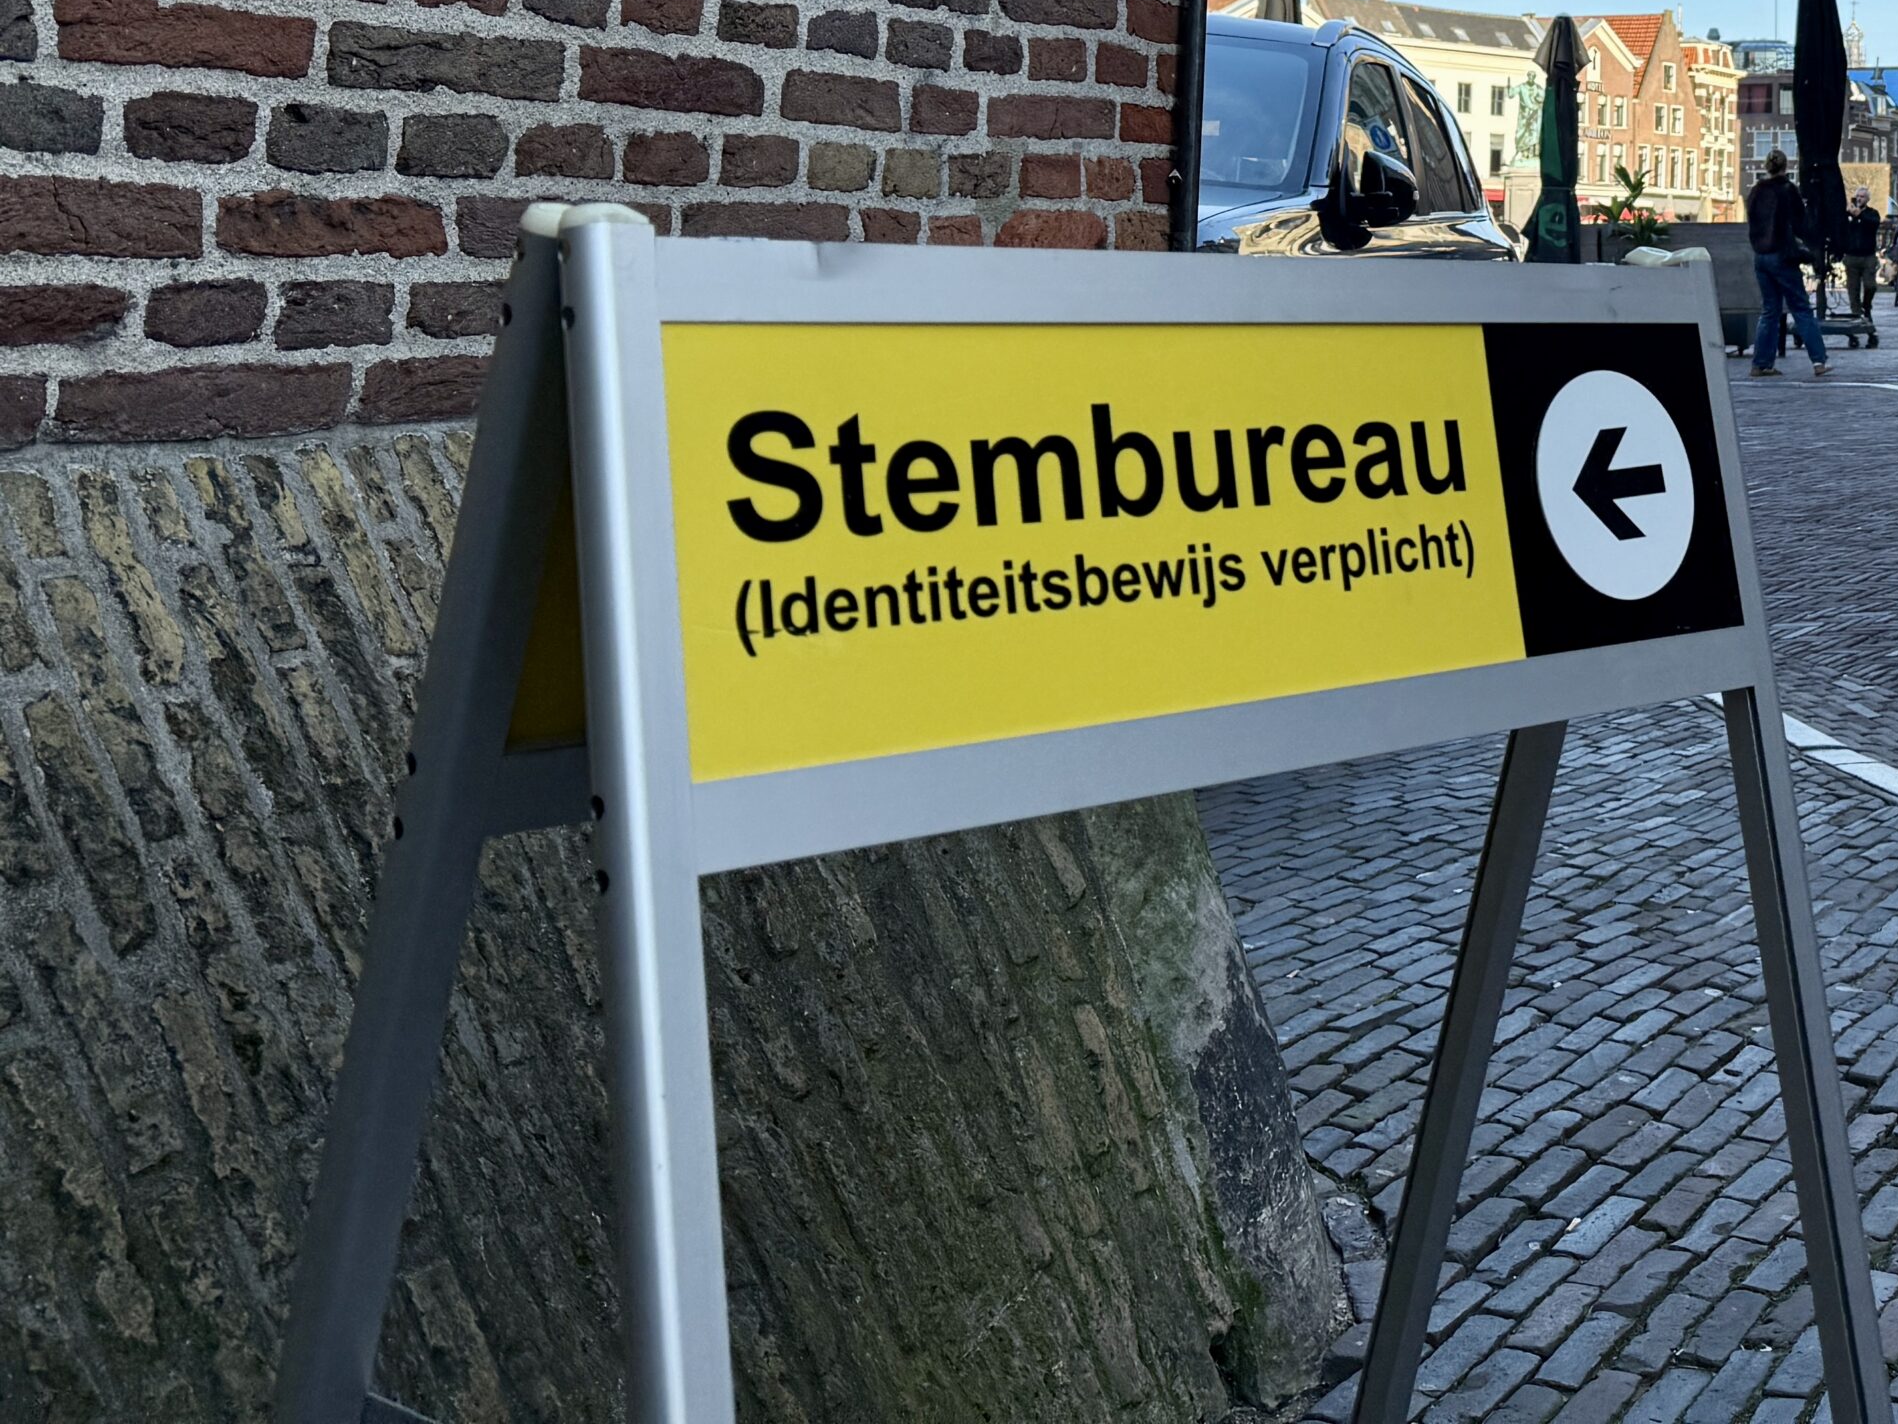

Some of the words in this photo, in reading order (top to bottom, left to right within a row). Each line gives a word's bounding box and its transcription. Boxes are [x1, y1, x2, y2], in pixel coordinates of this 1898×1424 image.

[726, 403, 1467, 543] Stembureau
[735, 544, 1246, 657] (Identiteitsbewijs
[1260, 519, 1476, 592] verplicht)
